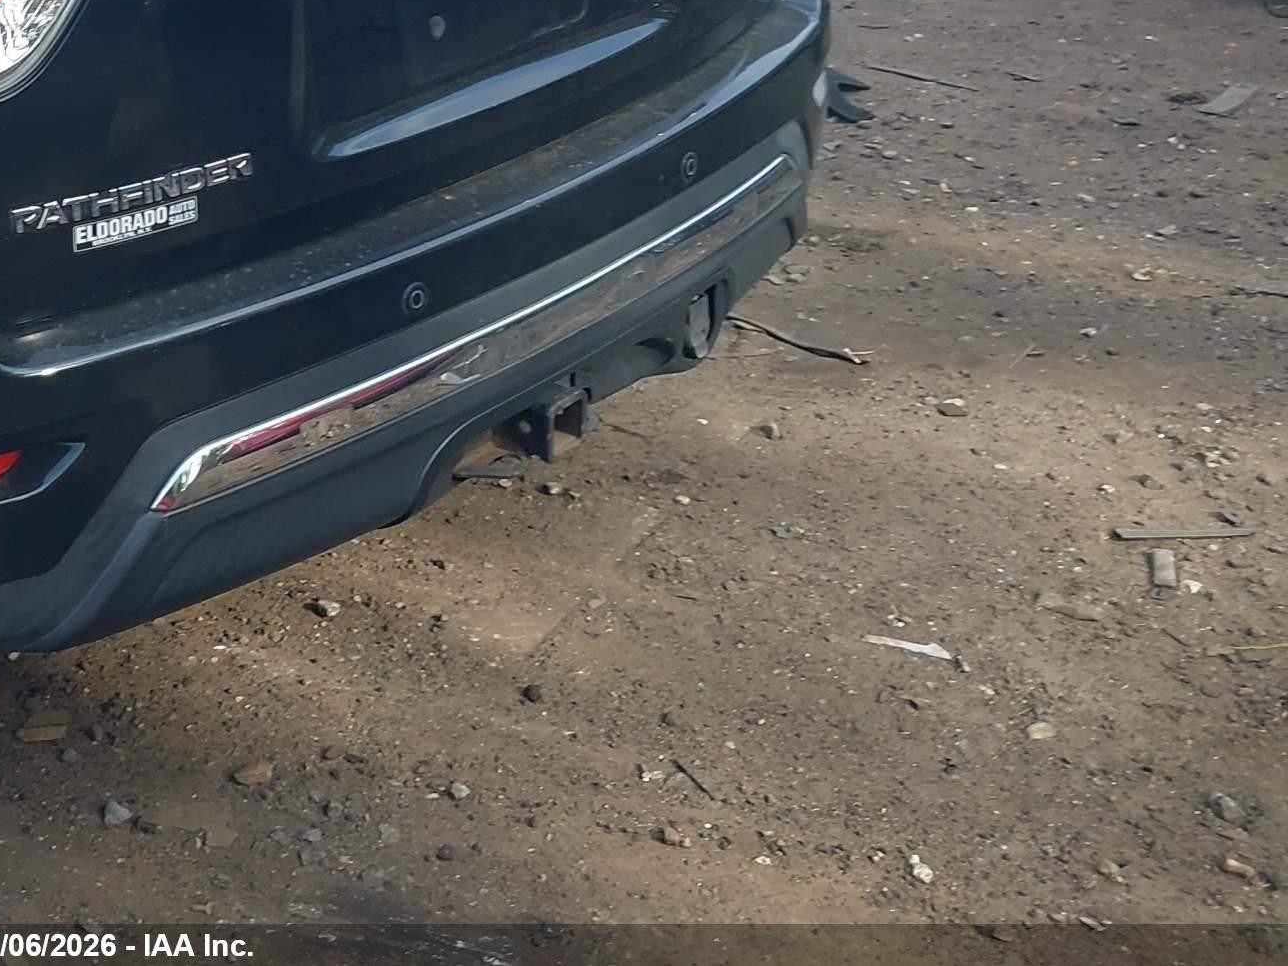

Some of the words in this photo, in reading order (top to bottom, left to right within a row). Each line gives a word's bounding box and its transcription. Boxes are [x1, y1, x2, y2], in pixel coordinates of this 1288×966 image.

[10, 152, 254, 234] PATHFINDER
[168, 210, 196, 226] SALES
[169, 199, 196, 215] AUTO
[76, 206, 168, 244] ELDORADO
